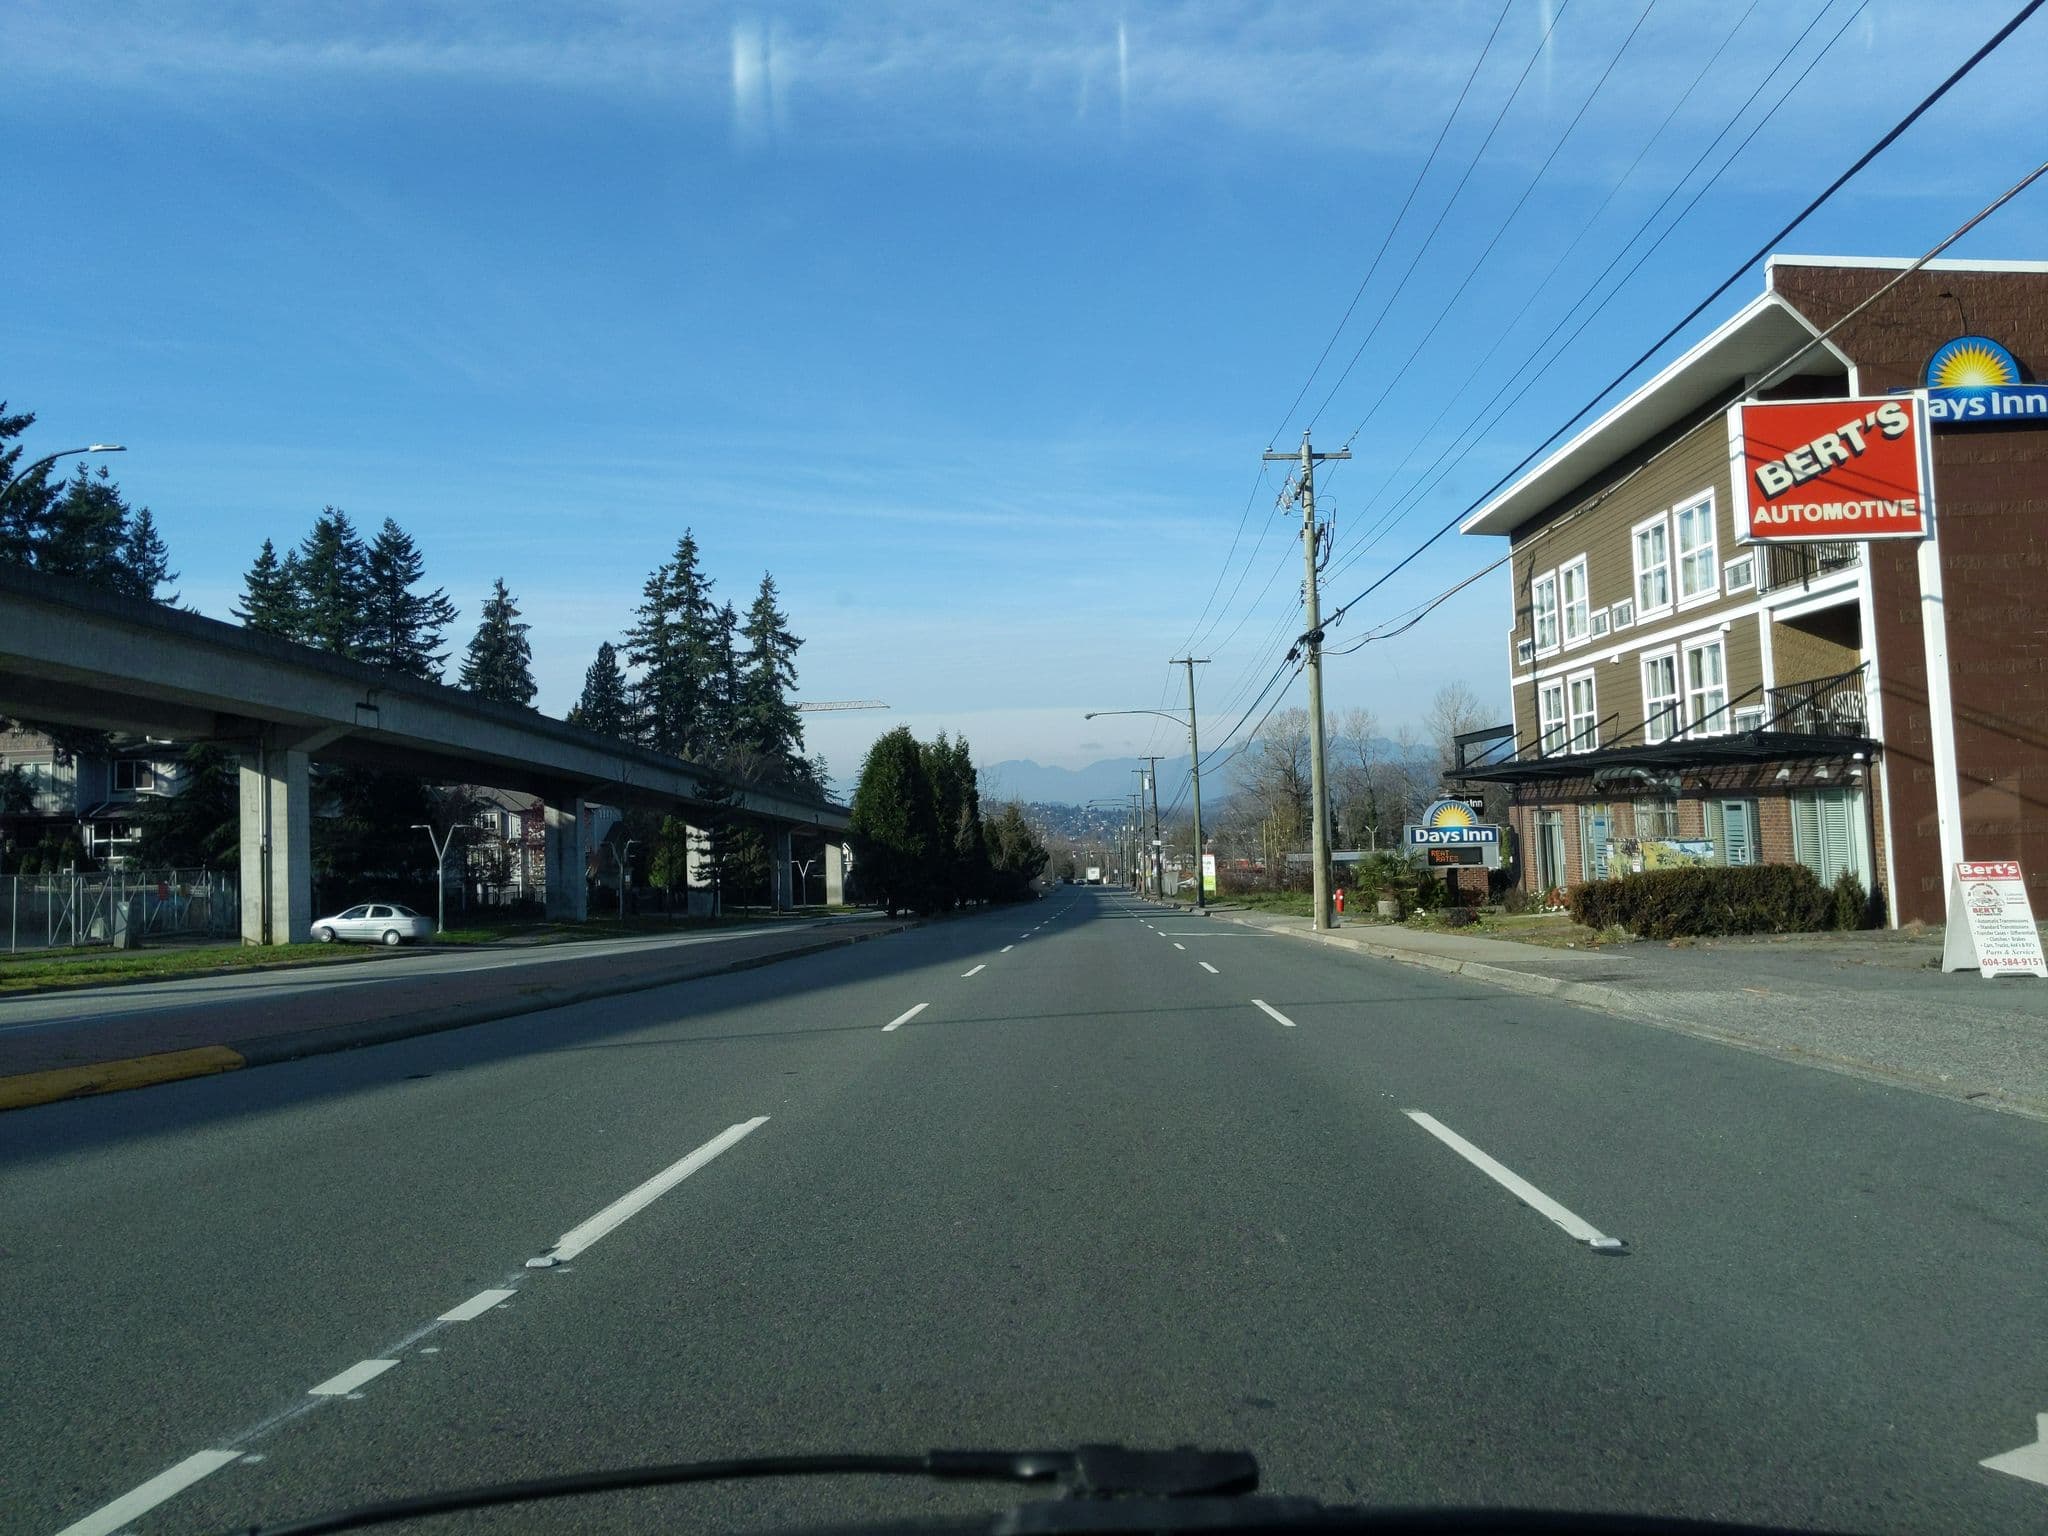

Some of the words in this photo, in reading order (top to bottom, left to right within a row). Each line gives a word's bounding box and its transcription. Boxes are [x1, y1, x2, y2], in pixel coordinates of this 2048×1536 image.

[1929, 397, 1986, 420] ays
[1991, 392, 2048, 415] Inn
[1755, 402, 1910, 500] BERT'S
[1753, 499, 1917, 524] AUTOMOTIVE
[1469, 799, 1483, 808] Inn
[1415, 830, 1460, 844] Days
[1463, 829, 1493, 842] Inn
[1958, 863, 2018, 875] Bert's
[1982, 958, 2043, 967] 604-584-9151
